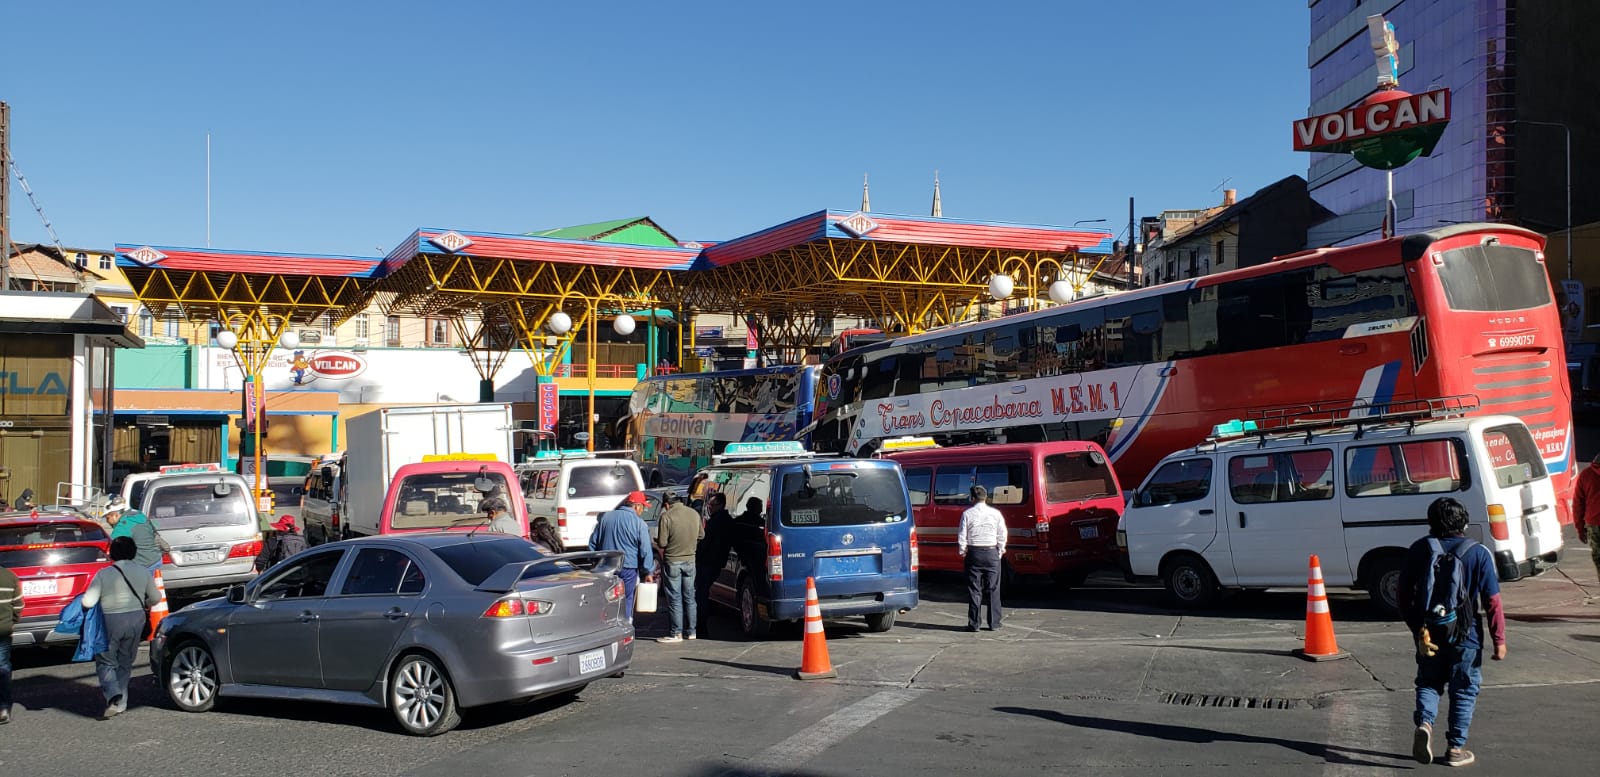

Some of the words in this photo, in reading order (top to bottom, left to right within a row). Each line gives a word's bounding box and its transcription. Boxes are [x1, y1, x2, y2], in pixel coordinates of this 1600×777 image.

[1297, 91, 1445, 145] VOLCAN
[848, 217, 872, 232] YPFB
[440, 235, 464, 248] YPFB
[1500, 335, 1535, 347] 69990757
[314, 359, 357, 371] VOLCAN
[878, 403, 925, 433] Trans
[930, 396, 1042, 427] Copacabana
[660, 414, 713, 436] Bolivar
